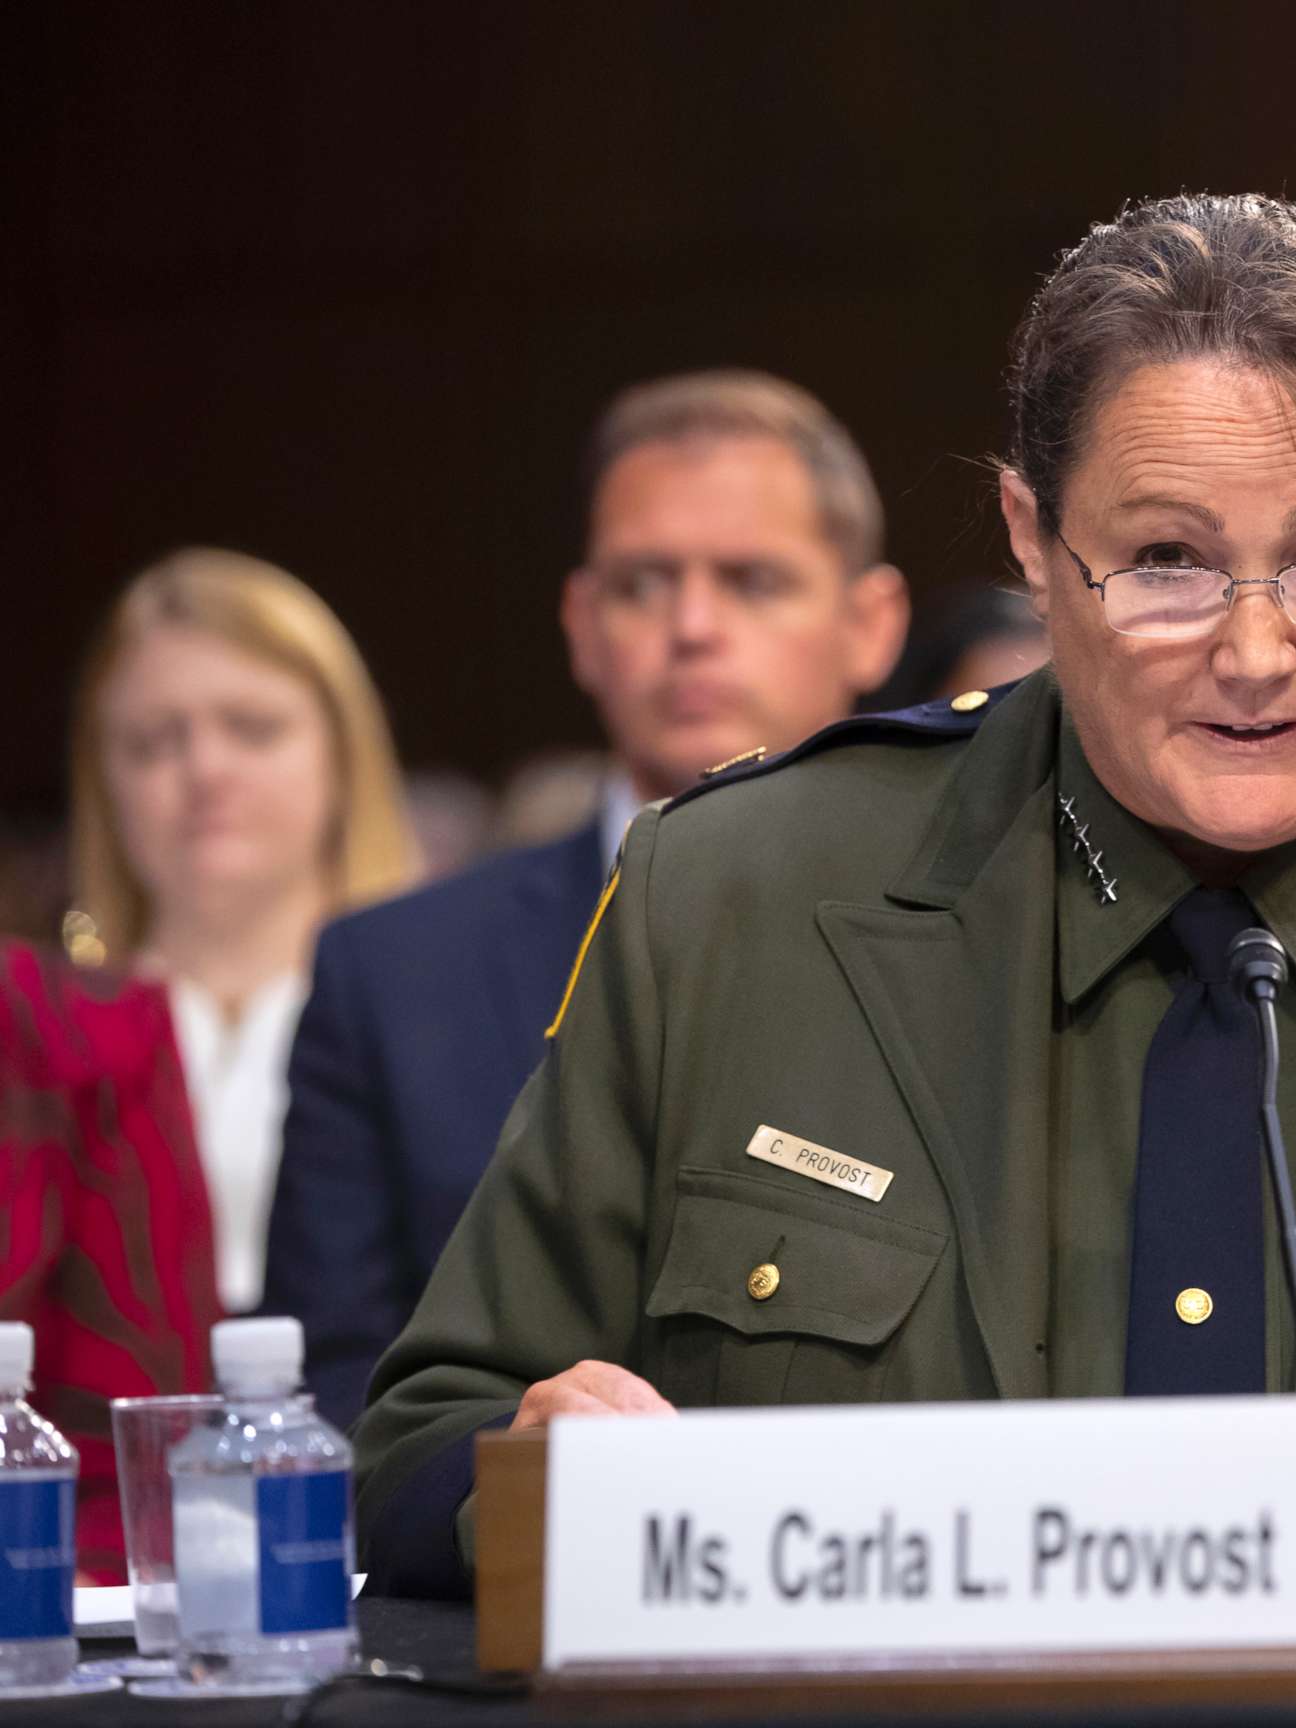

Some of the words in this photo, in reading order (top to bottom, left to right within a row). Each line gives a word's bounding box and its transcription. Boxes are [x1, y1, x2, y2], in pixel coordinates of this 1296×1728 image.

[769, 1139, 783, 1157] C.
[796, 1148, 872, 1187] PROVOST
[644, 1513, 746, 1604] Ms.
[771, 1509, 930, 1599] Carla
[954, 1510, 1006, 1597] L.
[1033, 1507, 1277, 1595] Provost
